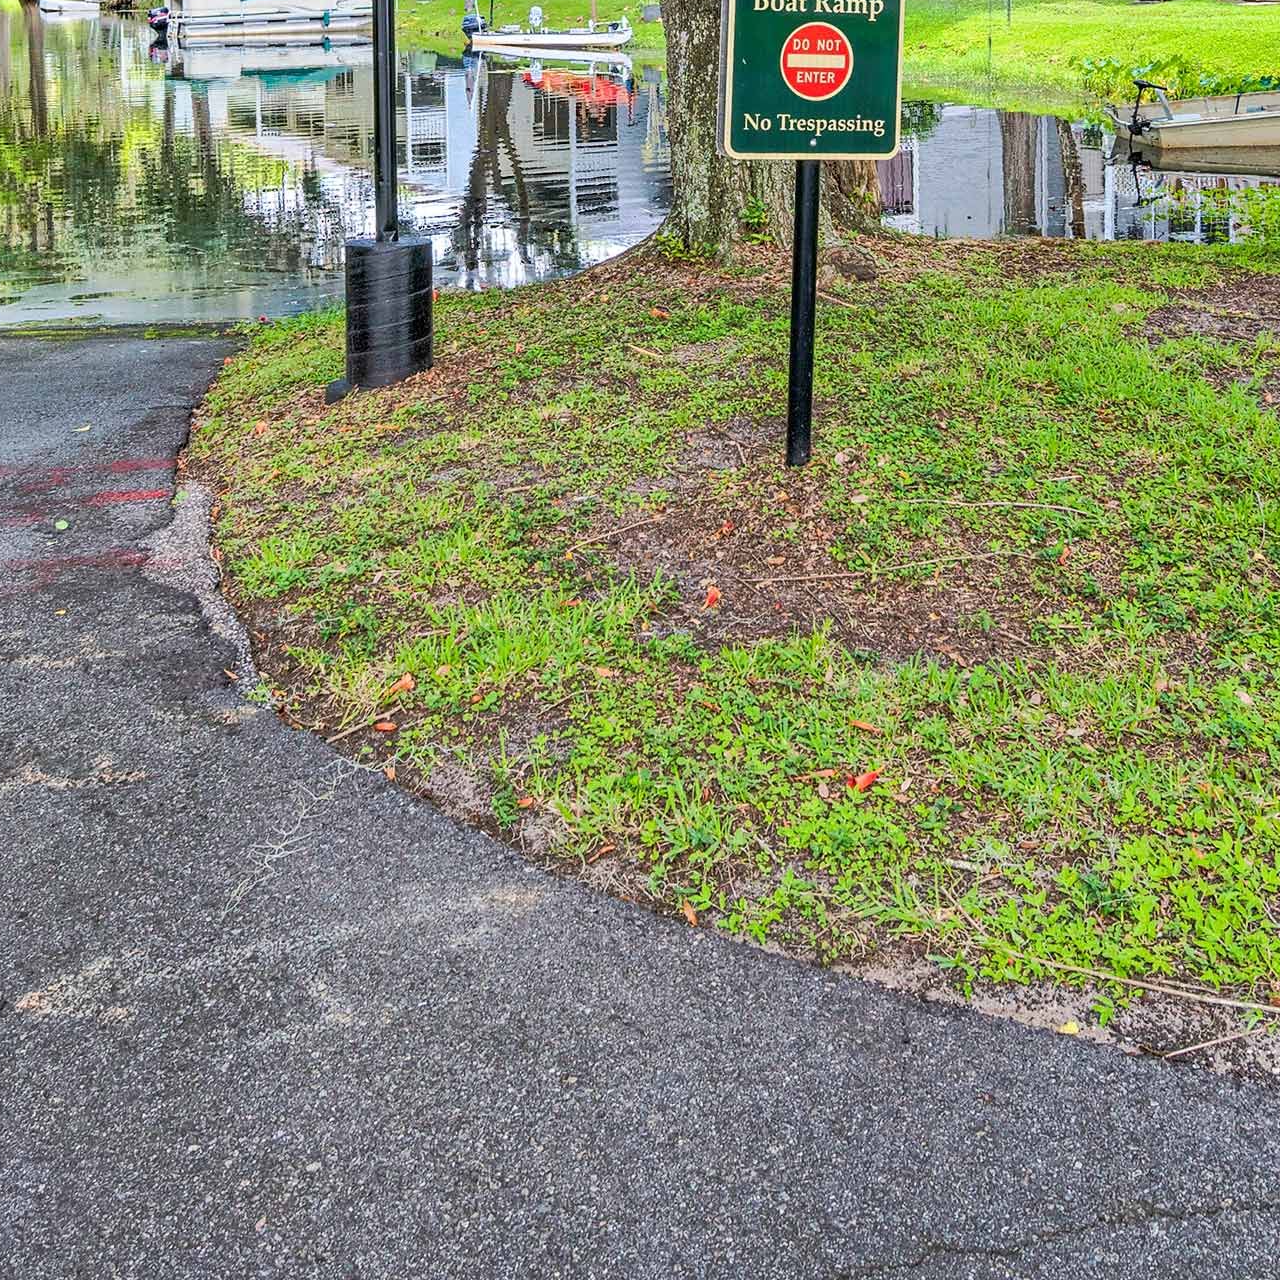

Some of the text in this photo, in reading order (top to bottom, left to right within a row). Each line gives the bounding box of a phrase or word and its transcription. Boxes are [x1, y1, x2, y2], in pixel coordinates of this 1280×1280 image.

[793, 38, 842, 52] DO NOT
[796, 71, 836, 84] ENTER
[743, 113, 886, 137] No Trespassing
